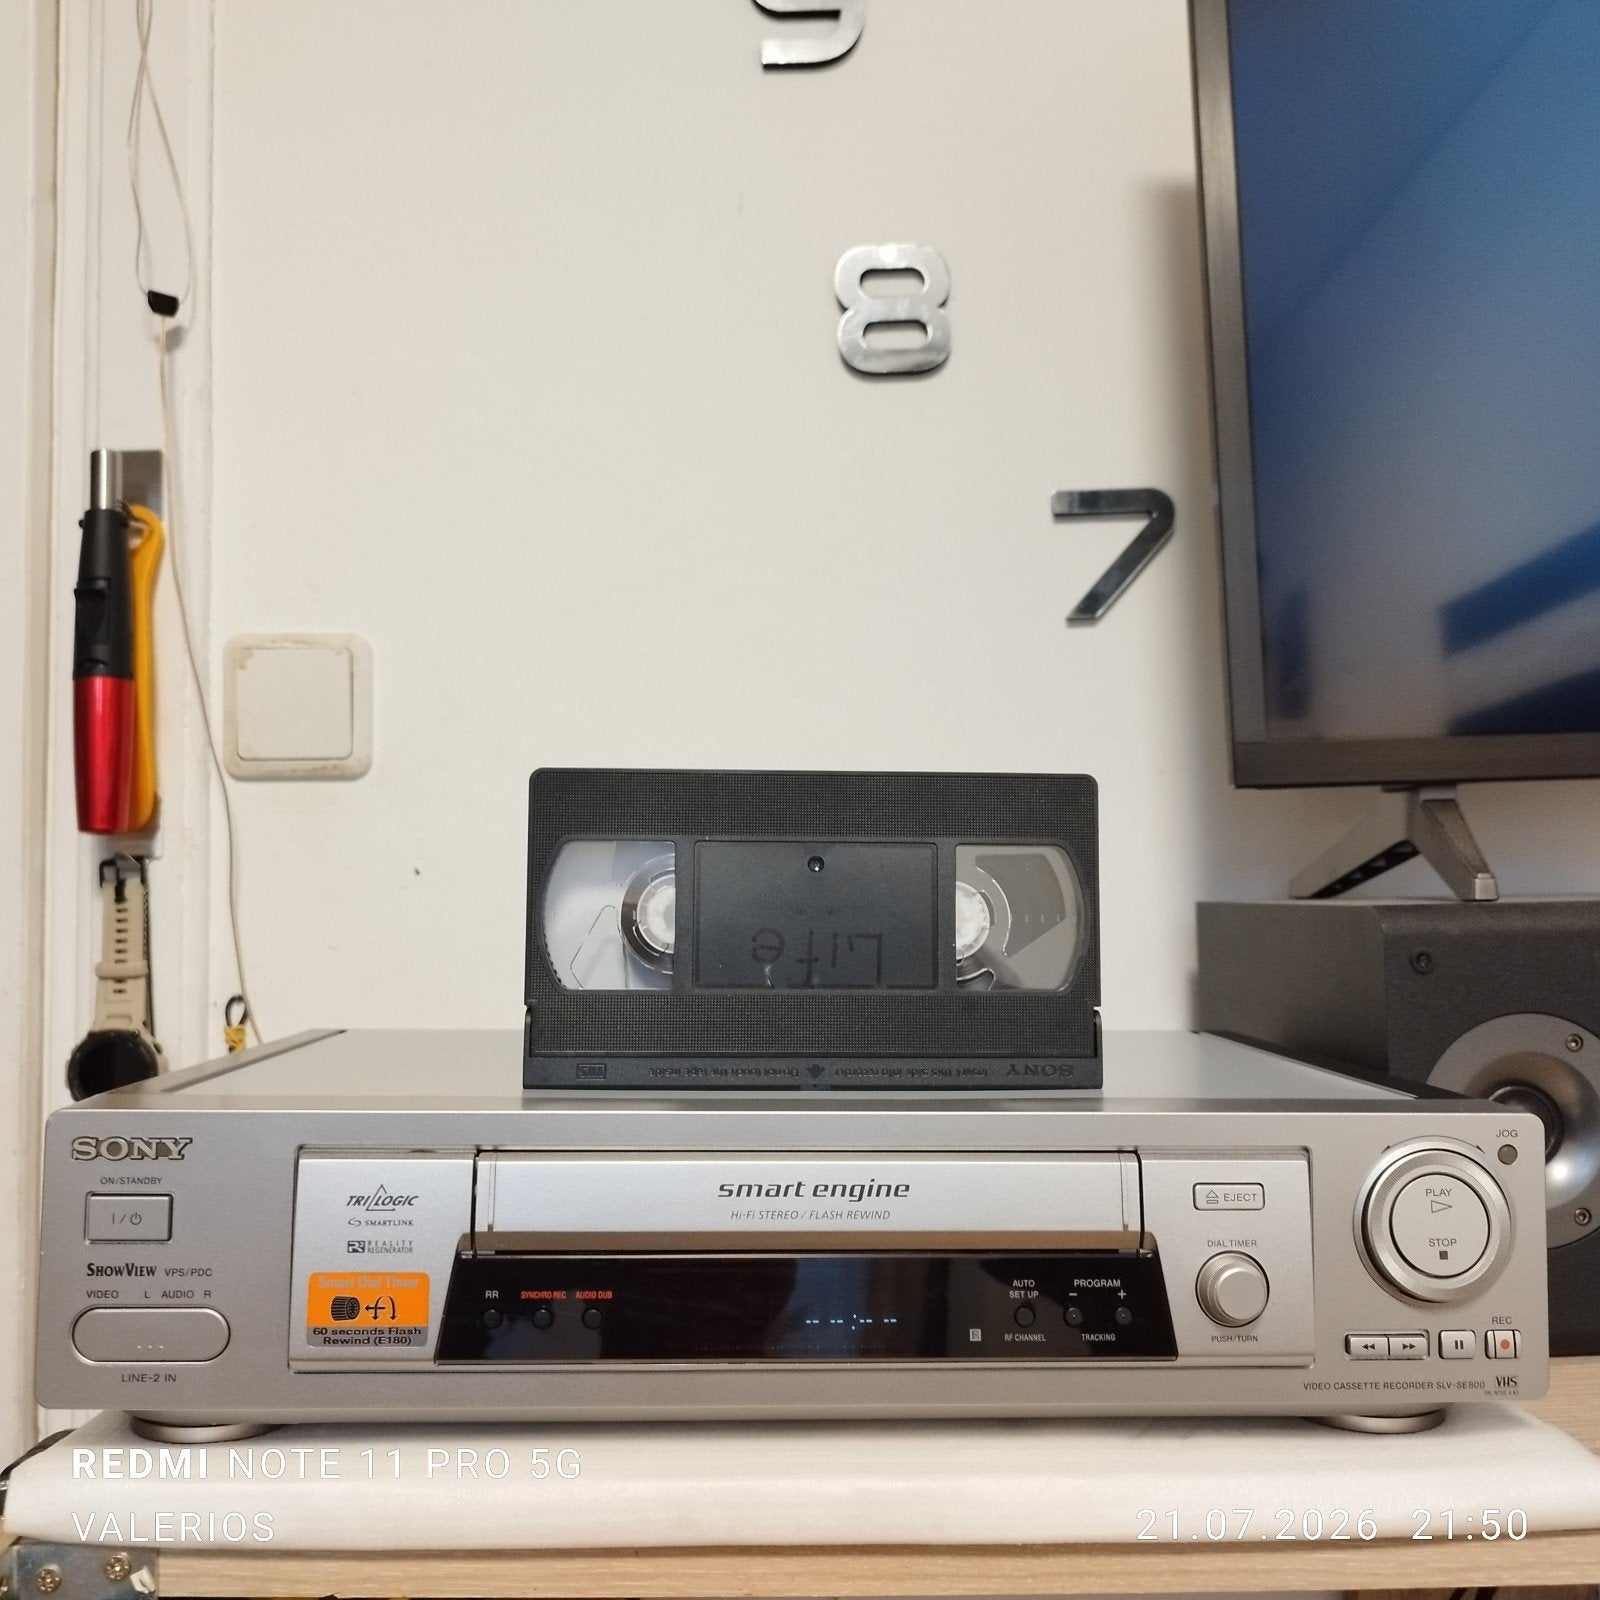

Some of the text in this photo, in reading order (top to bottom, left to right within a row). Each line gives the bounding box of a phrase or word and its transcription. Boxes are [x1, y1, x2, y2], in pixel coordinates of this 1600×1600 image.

[834, 243, 950, 374] 8
[1050, 487, 1175, 621] 7
[1006, 1064, 1075, 1077] SONY
[1496, 1130, 1518, 1138] JOG
[72, 1136, 193, 1161] SONY
[100, 1177, 163, 1185] ON/STANDBY
[718, 1179, 911, 1203] smart engine
[1425, 1188, 1452, 1197] PLAY
[1223, 1193, 1258, 1202] EJECT
[730, 1210, 756, 1220] Hi-Fi
[759, 1210, 799, 1220] STEREO
[809, 1210, 844, 1220] FLASH
[846, 1210, 891, 1220] REWIND
[1207, 1239, 1257, 1248] DIAL TIMER
[1428, 1238, 1457, 1248] STOP
[164, 1268, 213, 1277] VPS/PDC
[1012, 1279, 1035, 1287] AUTO
[1074, 1279, 1121, 1288] PROGRAM
[86, 1290, 212, 1299] VIDEO L AUDIO R
[520, 1290, 567, 1299] SYNCHRO REC
[575, 1290, 613, 1299] AUDIO DUB
[1009, 1290, 1039, 1299] SET UP
[1491, 1316, 1512, 1325] REC
[313, 1327, 422, 1336] 60 seconds Flash
[323, 1336, 412, 1346] Rewind (E180)
[1004, 1333, 1046, 1342] RF CHANNEL
[1081, 1333, 1116, 1342] TRACKING
[1211, 1335, 1259, 1343] PUSH/TURN
[121, 1374, 177, 1383] LINE-2 IN
[1495, 1376, 1519, 1388] VHS
[1303, 1380, 1486, 1390] VIDEO CASSETTE RECORDER SLV-SE800
